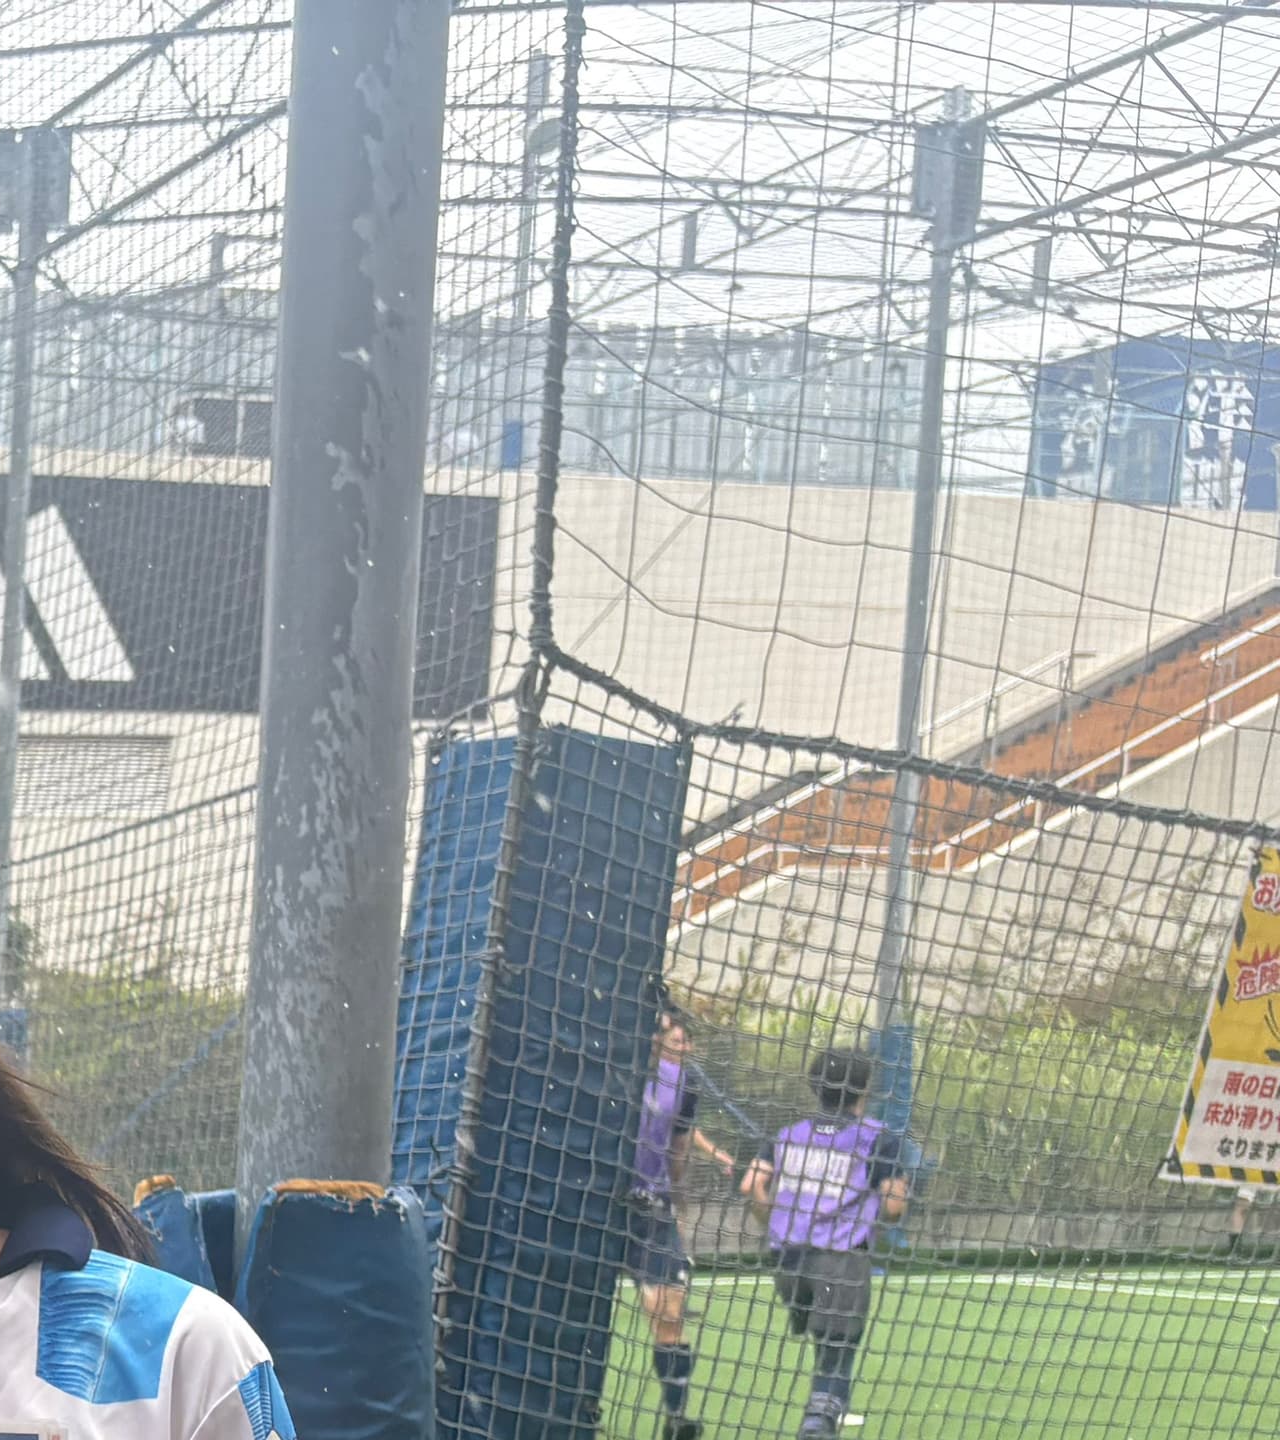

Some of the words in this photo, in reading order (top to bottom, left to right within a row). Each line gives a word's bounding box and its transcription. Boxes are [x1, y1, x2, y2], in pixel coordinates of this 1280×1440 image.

[1222, 1071, 1280, 1098] 雨の日
[1202, 1102, 1280, 1133] 床が滑り
